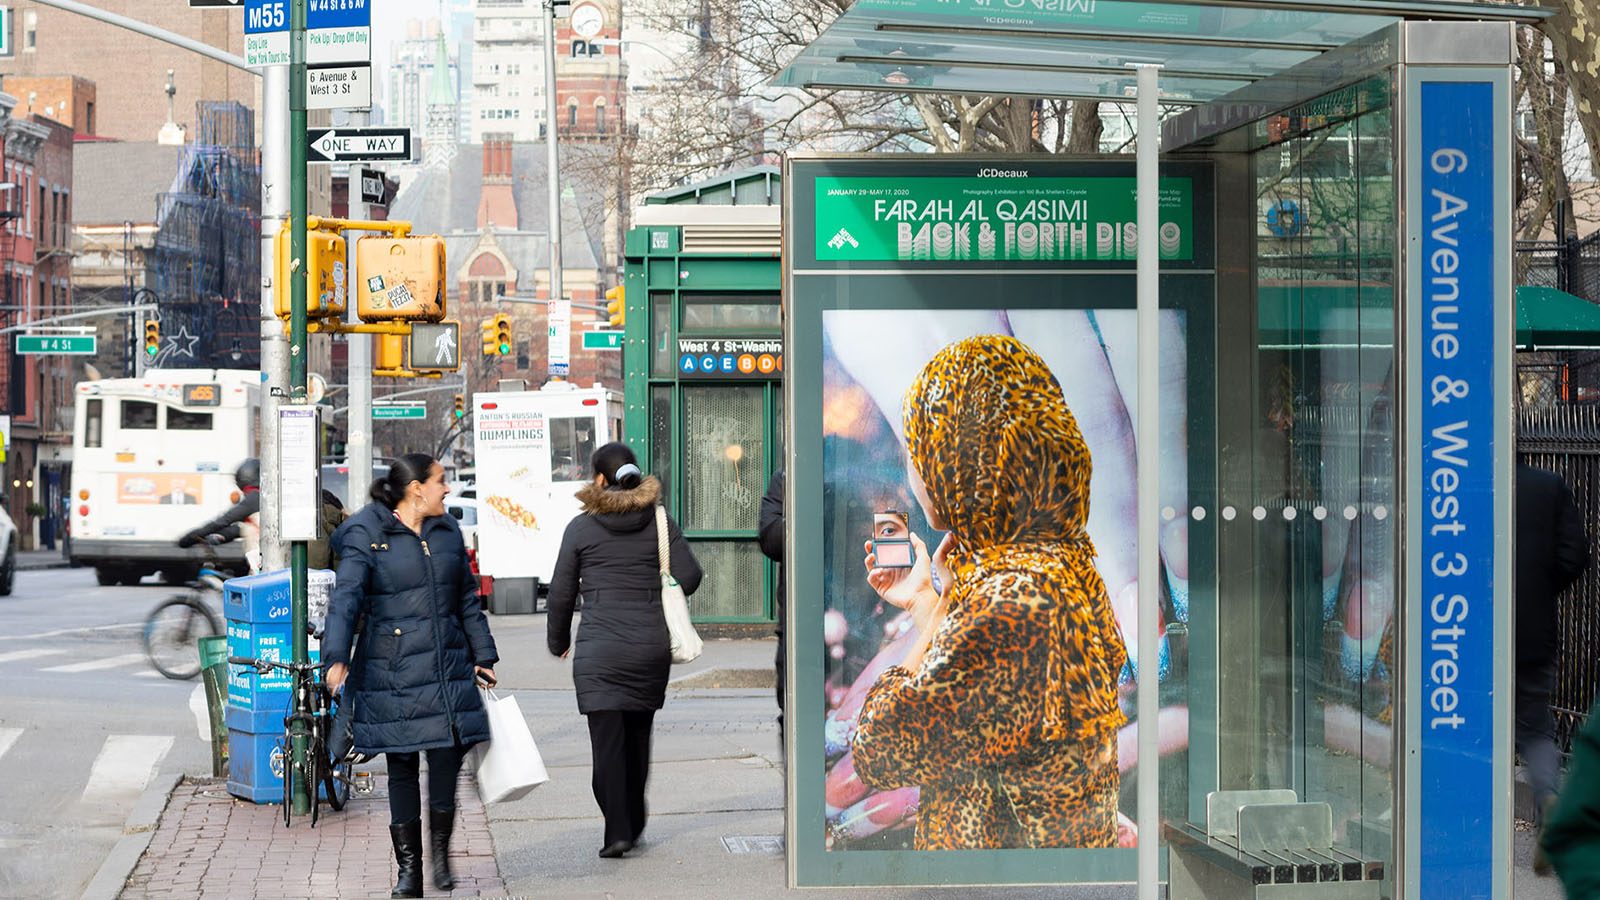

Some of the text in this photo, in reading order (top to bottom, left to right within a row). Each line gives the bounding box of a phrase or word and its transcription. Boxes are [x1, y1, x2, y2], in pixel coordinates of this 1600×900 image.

[319, 0, 328, 11] 44
[249, 2, 285, 29] M55
[310, 33, 321, 44] Pick
[333, 32, 345, 45] Drop
[346, 32, 354, 43] Off
[356, 31, 367, 45] Only
[248, 38, 268, 52] Gray Line
[248, 54, 256, 64] New
[258, 53, 267, 64] York
[268, 52, 280, 64] Tours
[310, 70, 357, 82] 6 Avenue &
[310, 83, 350, 95] West 3 St
[322, 138, 397, 152] ONE WAY
[976, 168, 1028, 178] JCDecaux
[874, 200, 1088, 220] FARAH AL QASIMI
[898, 222, 1180, 255] BACK & FORTH DISO
[41, 340, 72, 350] W 4 St
[608, 335, 616, 346] W
[680, 341, 708, 352] West
[712, 341, 720, 352] 4
[512, 412, 543, 420] RUSSIAN
[480, 429, 544, 440] DUMPLINGS
[1430, 148, 1469, 730] 6 Avenue & West 3 Street
[260, 638, 277, 646] FREE
